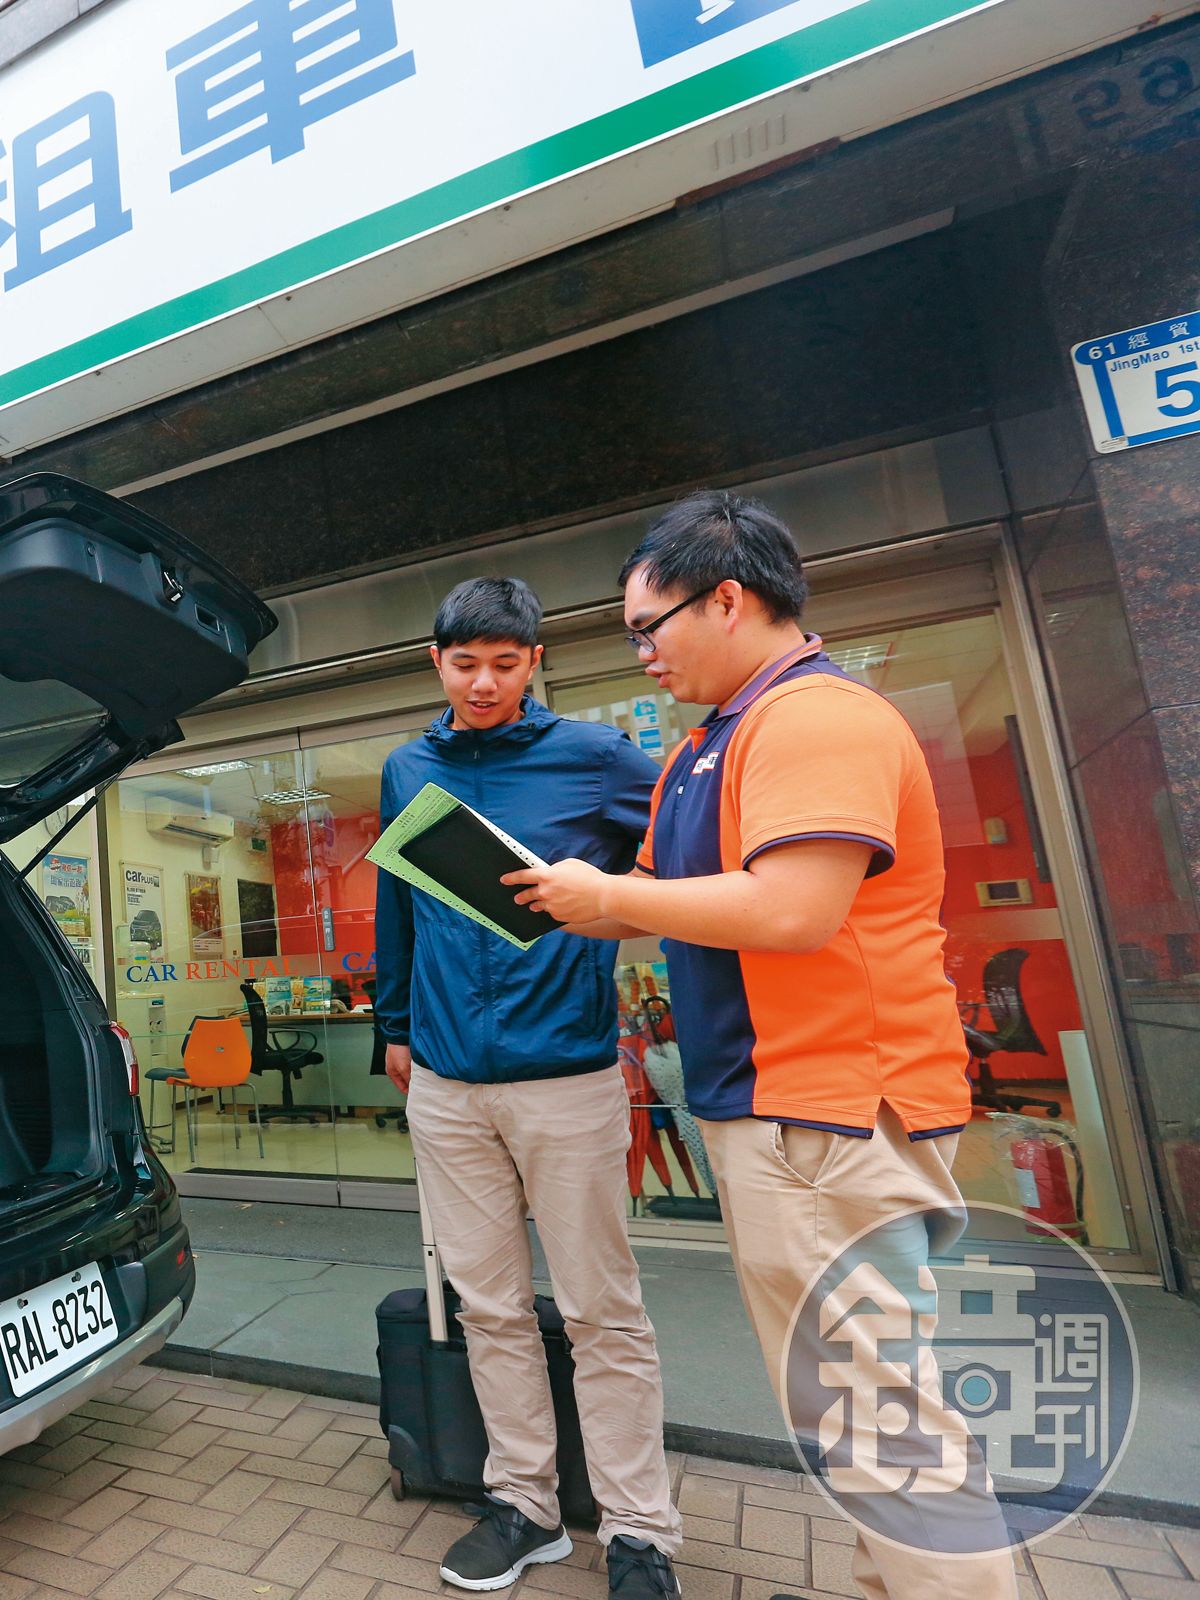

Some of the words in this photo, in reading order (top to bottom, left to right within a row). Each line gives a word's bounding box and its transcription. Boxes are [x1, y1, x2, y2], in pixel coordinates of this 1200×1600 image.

[1088, 341, 1117, 360] 61
[1127, 321, 1191, 350] 經貿
[1110, 350, 1170, 373] JingMao
[1155, 360, 1200, 418] 5
[126, 963, 178, 983] CAR
[185, 956, 296, 981] RENTAL
